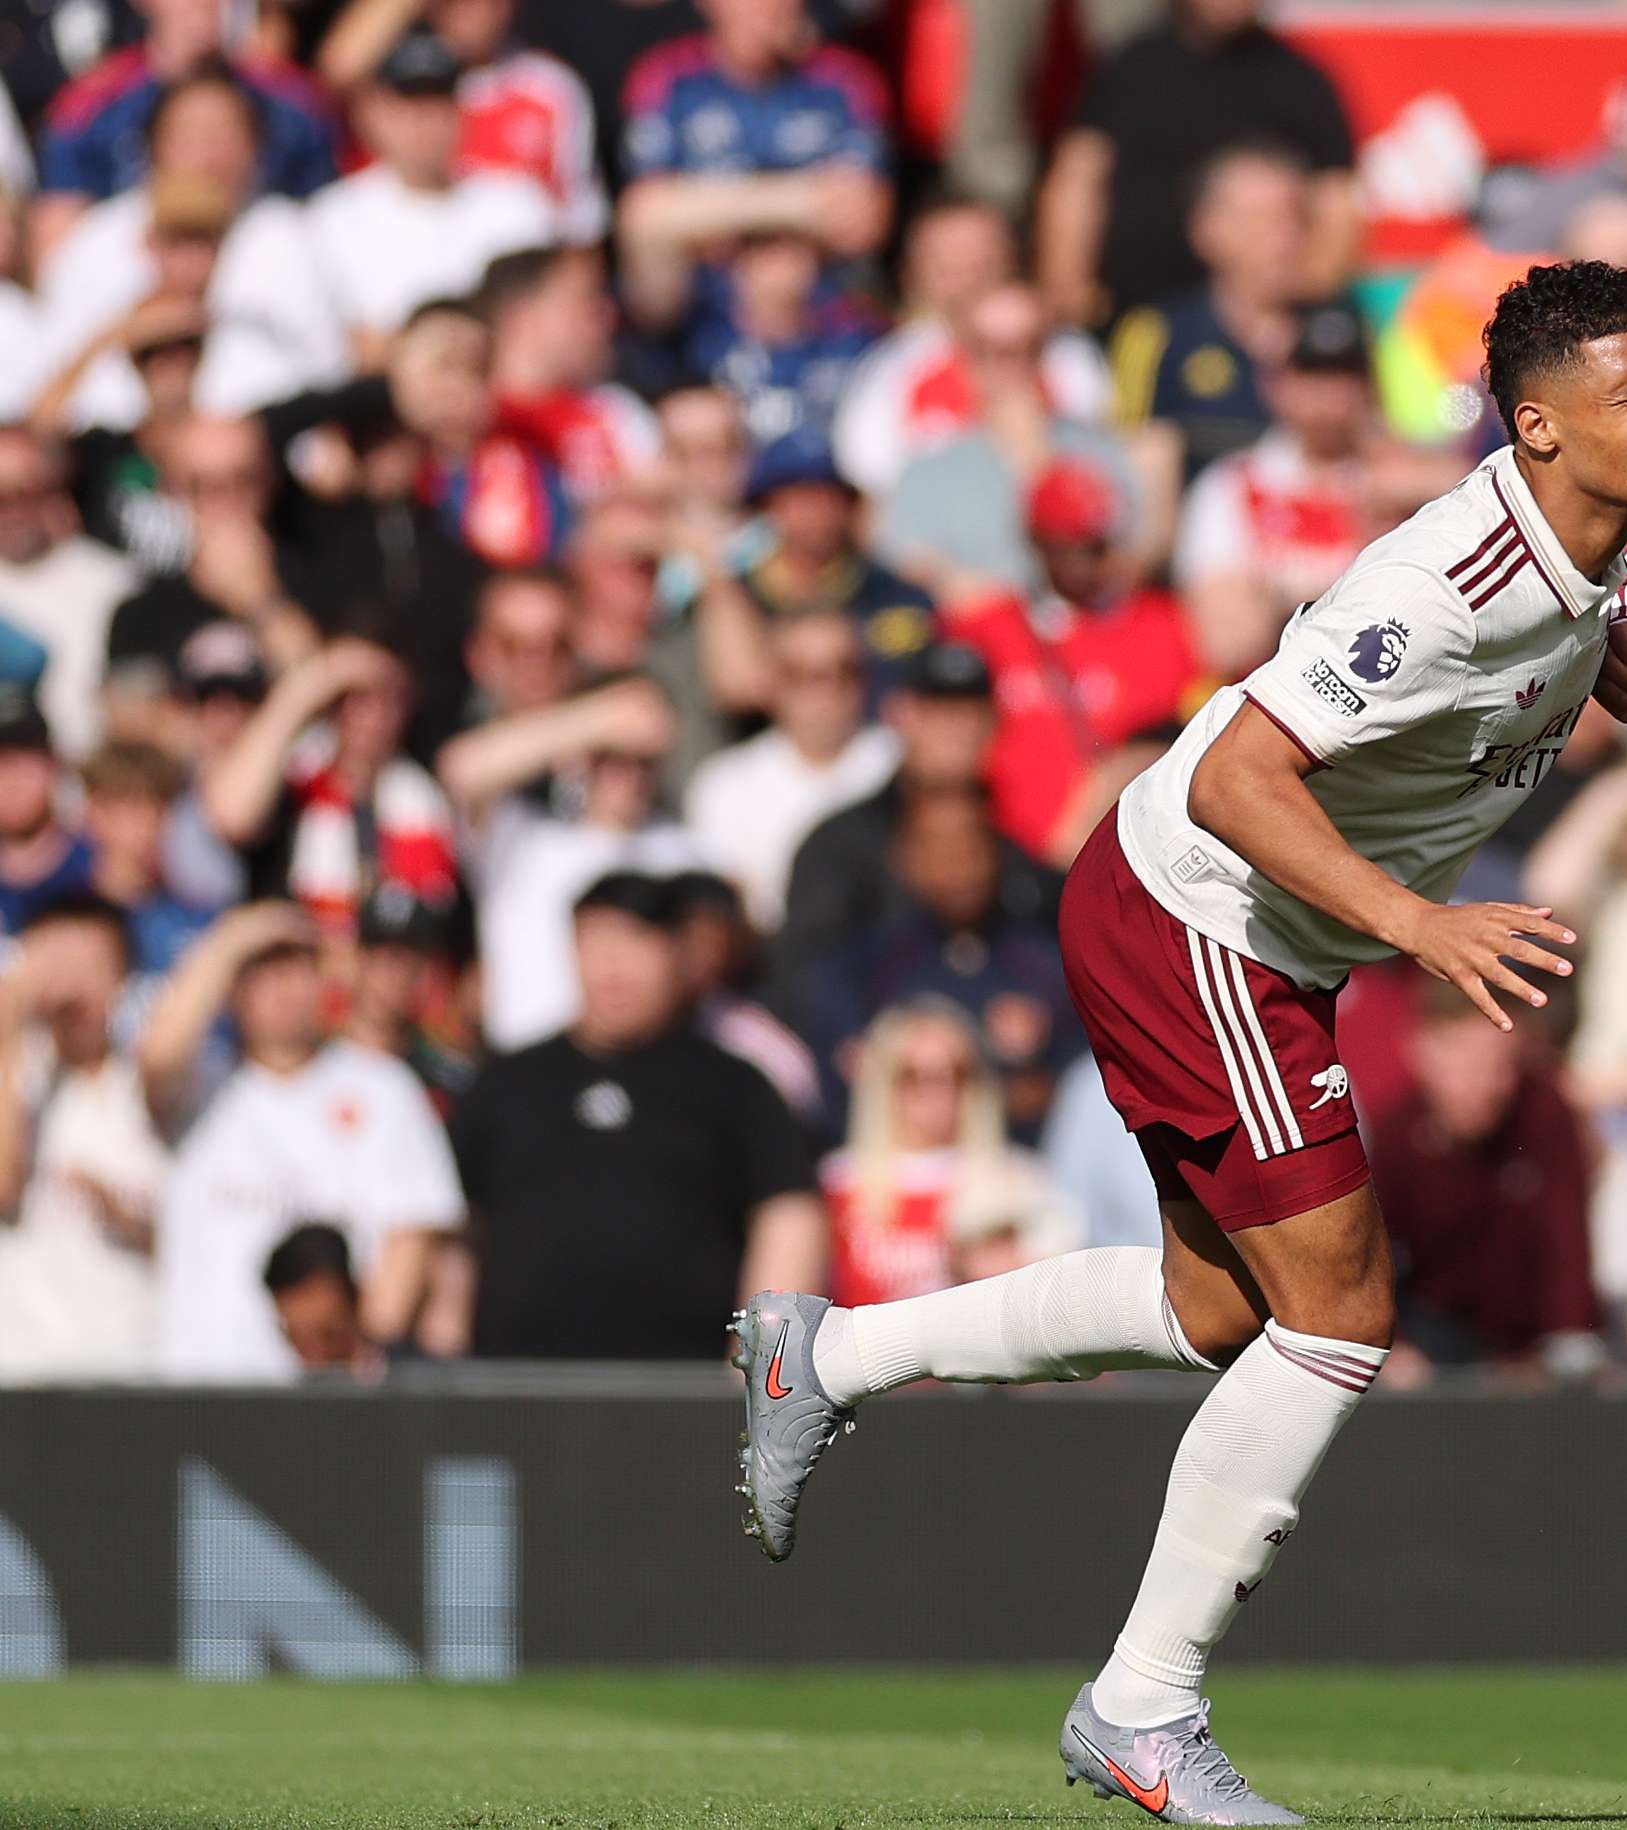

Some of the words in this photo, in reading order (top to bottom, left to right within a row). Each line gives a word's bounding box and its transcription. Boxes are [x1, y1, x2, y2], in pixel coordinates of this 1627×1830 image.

[1311, 657, 1330, 678] No
[1325, 673, 1360, 710] room
[1315, 682, 1355, 717] racism
